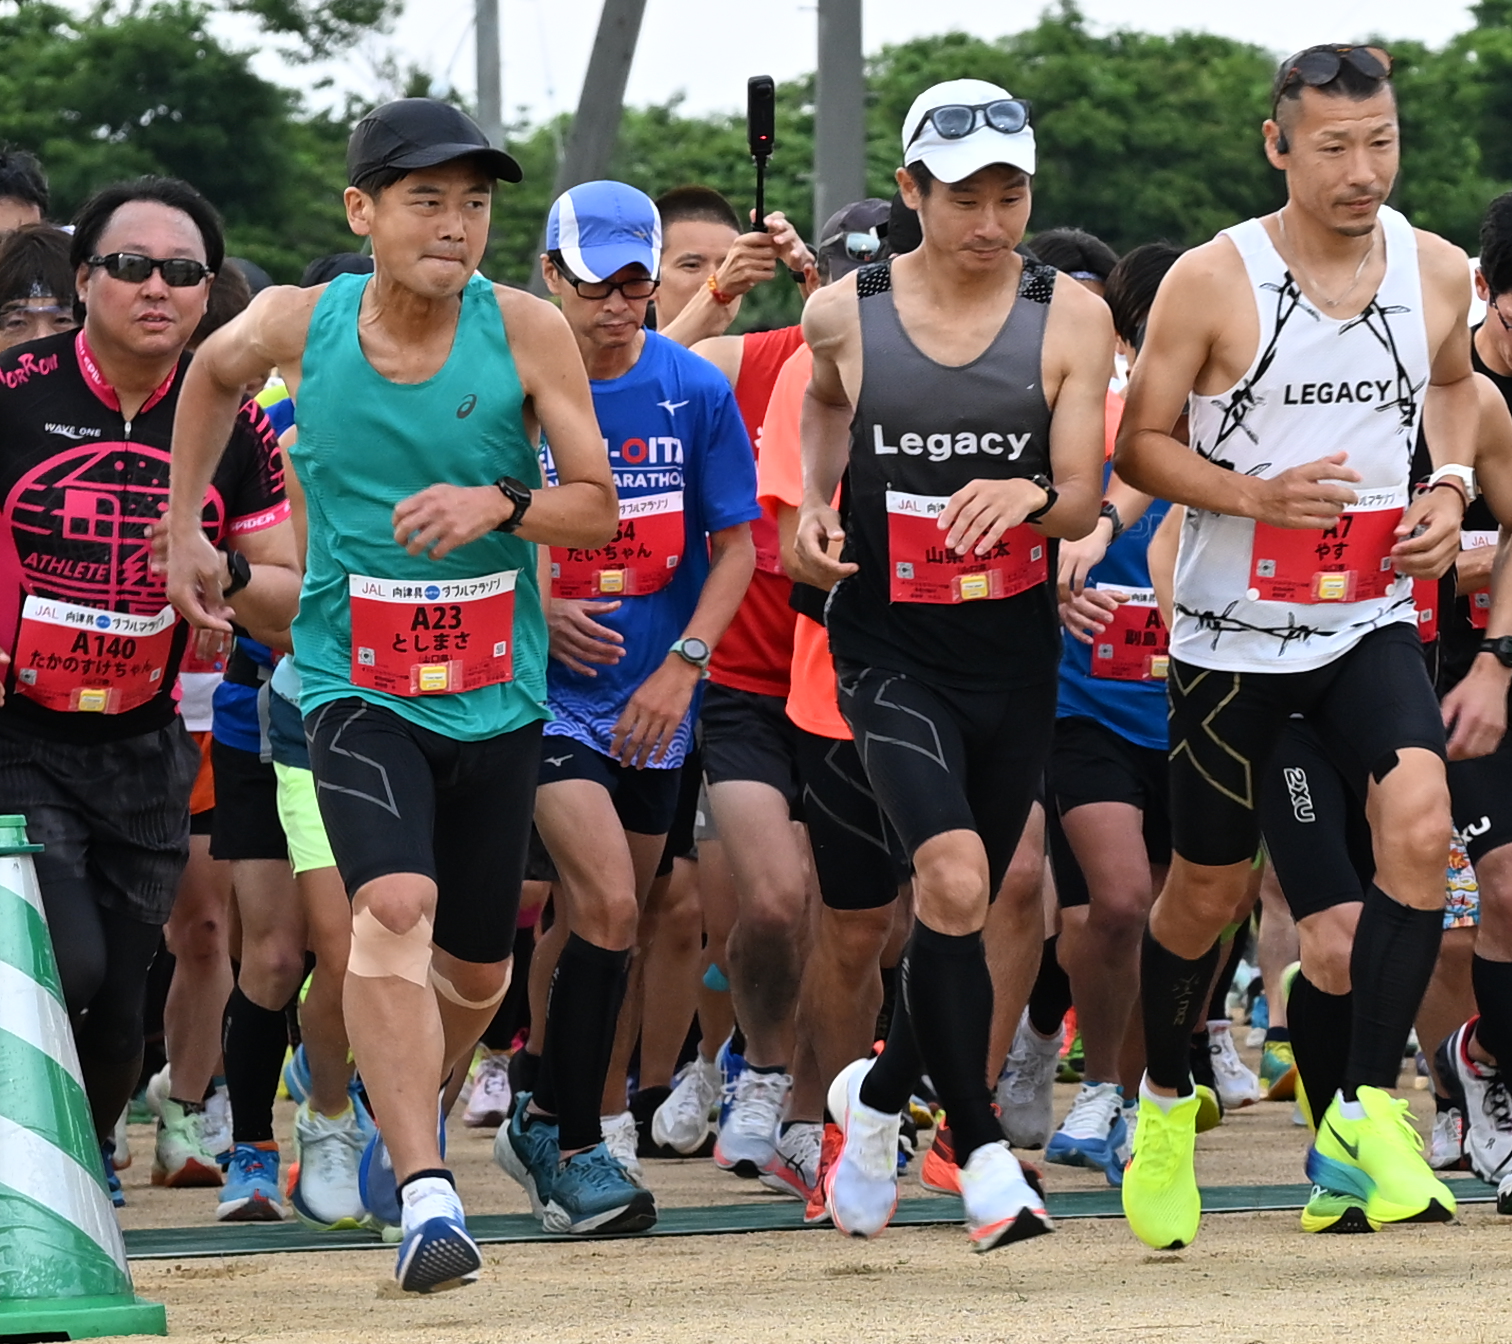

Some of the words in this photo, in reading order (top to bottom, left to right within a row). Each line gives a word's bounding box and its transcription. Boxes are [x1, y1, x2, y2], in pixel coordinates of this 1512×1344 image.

[1283, 379, 1392, 406] LEGACY
[79, 427, 101, 438] ONE
[873, 423, 1033, 462] Legacy
[613, 470, 686, 488] ARATHO
[898, 499, 922, 513] JAL
[1322, 515, 1353, 540] A7
[1315, 542, 1349, 561] やす
[23, 552, 111, 582] ATHLETE
[362, 582, 387, 597] JAL
[442, 578, 501, 598] ダブルマラソン
[35, 605, 59, 620] JAL
[410, 605, 462, 632] A23
[71, 630, 137, 660] A140
[392, 632, 471, 653] としまさ
[30, 650, 153, 678] たかのすけちゃん
[1283, 766, 1316, 824] 2XU
[1460, 815, 1492, 845] XU
